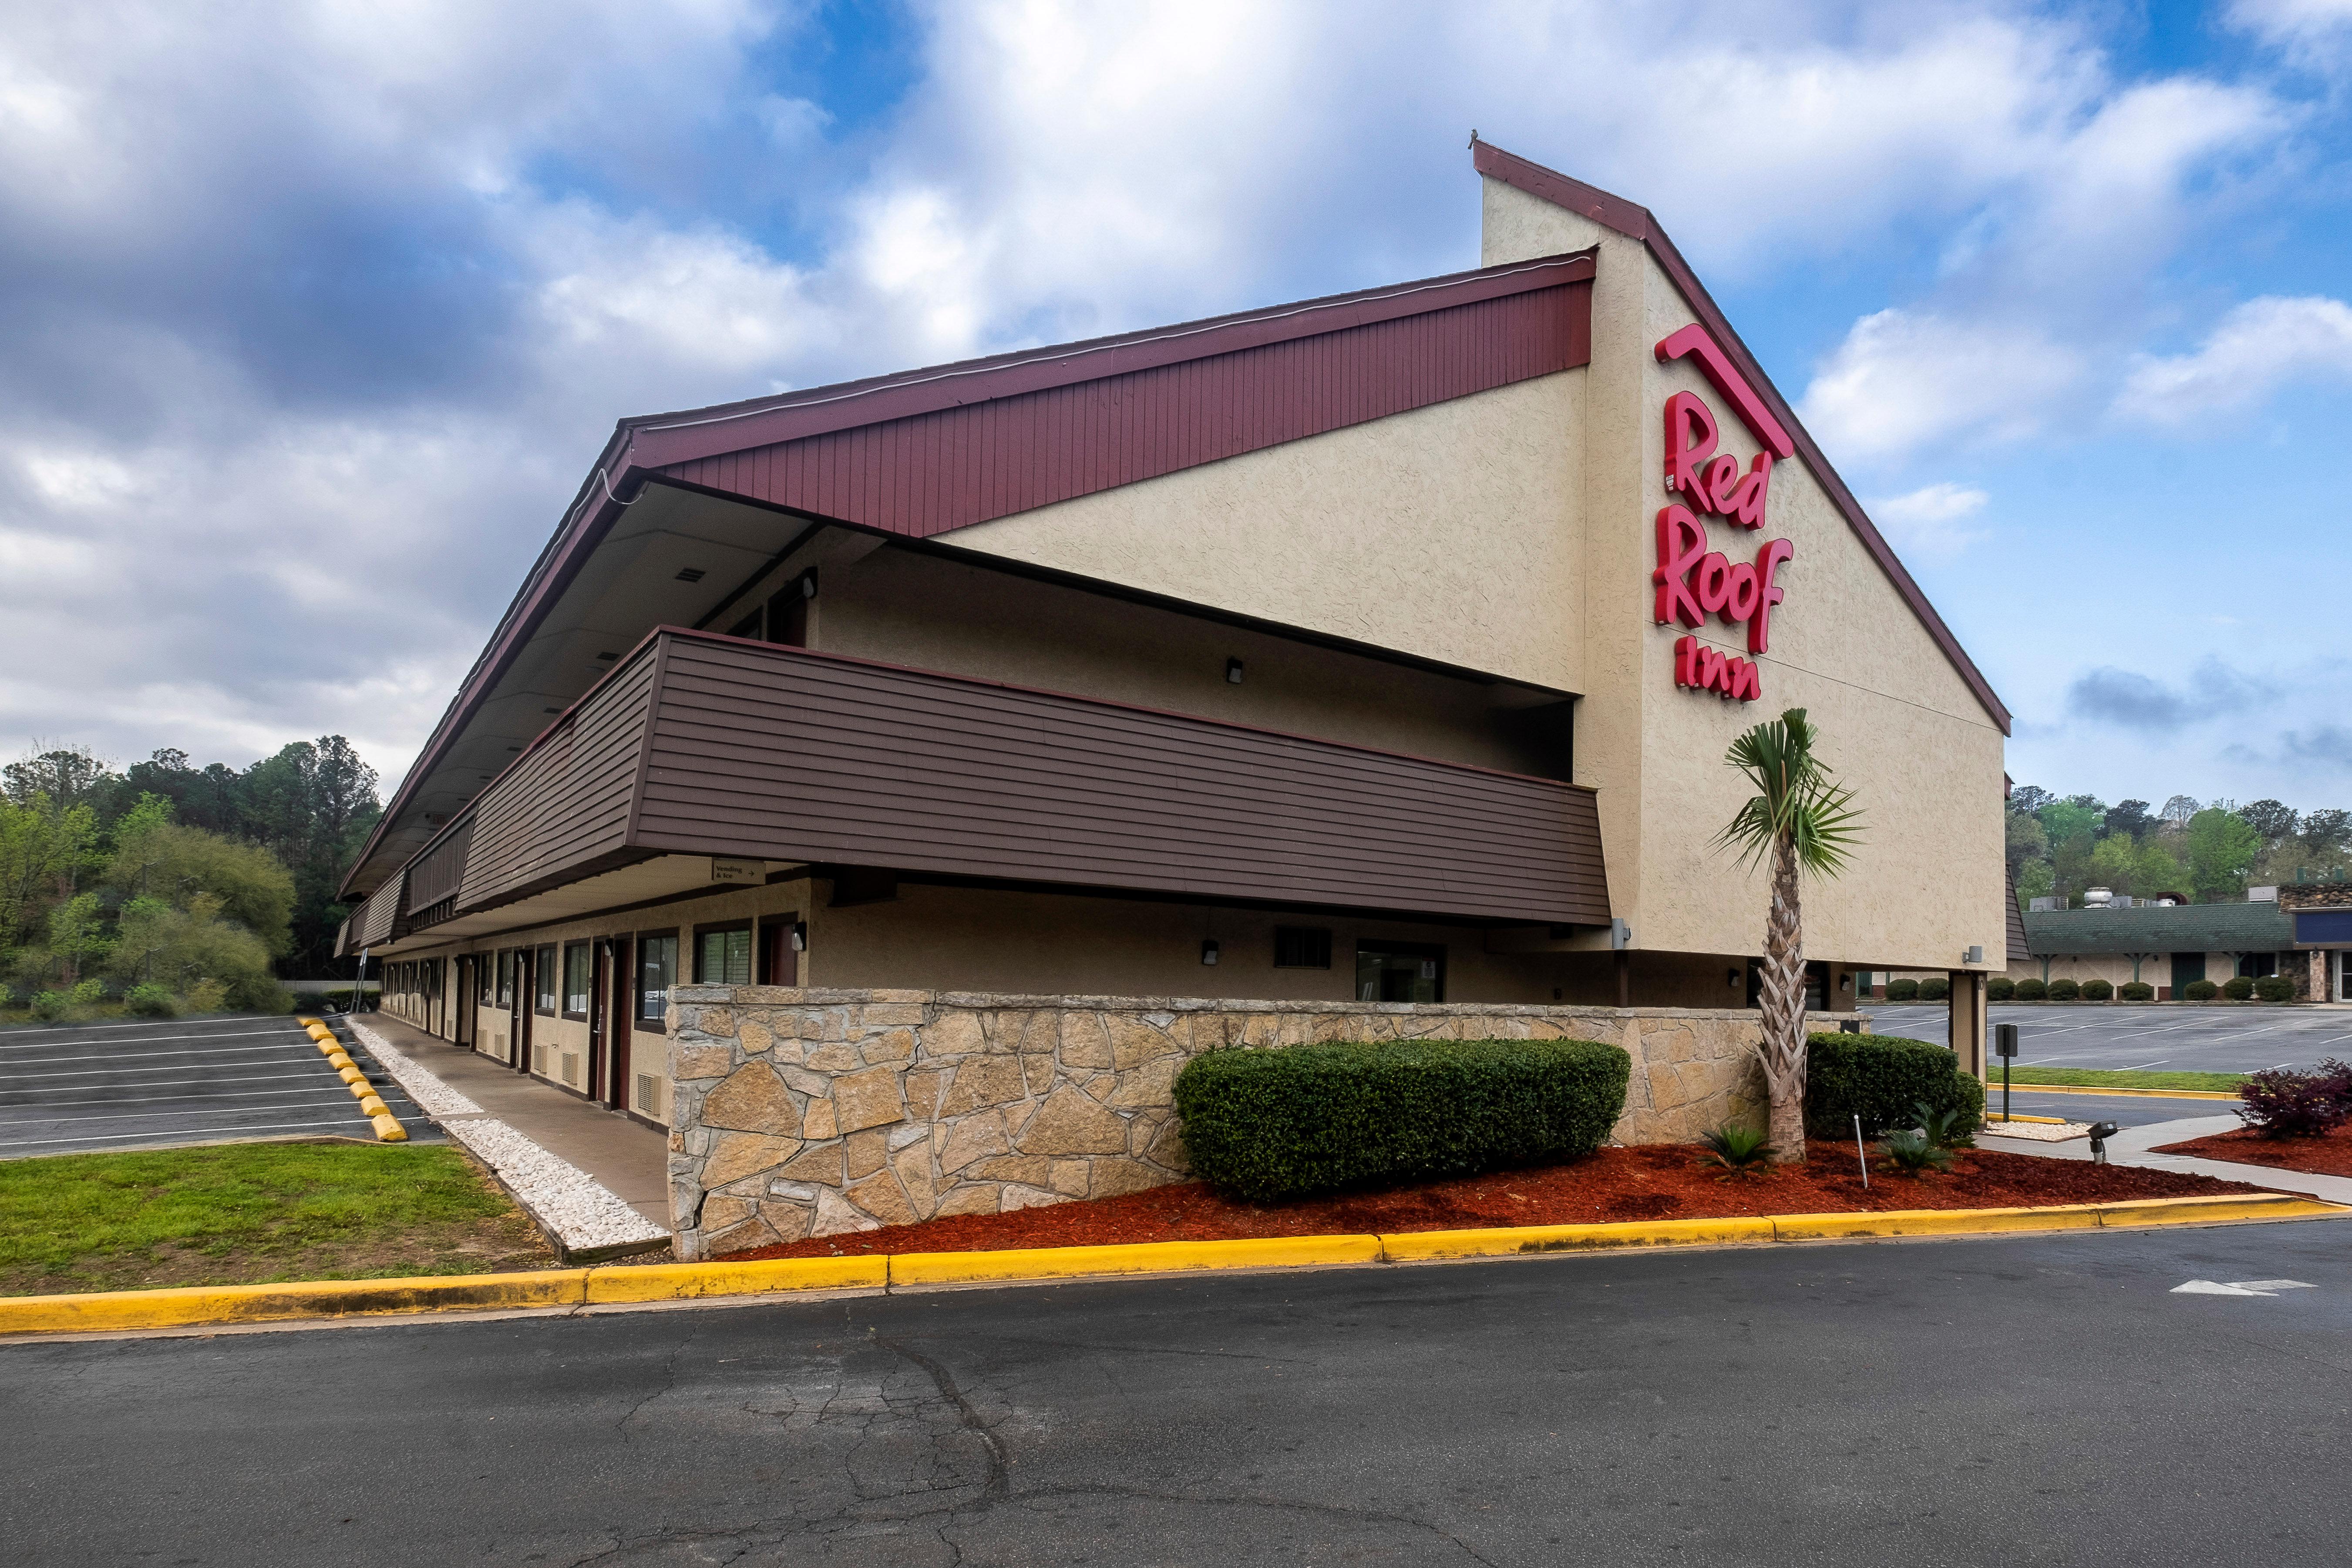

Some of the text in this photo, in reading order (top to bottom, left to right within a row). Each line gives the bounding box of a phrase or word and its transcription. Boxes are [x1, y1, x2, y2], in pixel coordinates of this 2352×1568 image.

[1666, 390, 1773, 530] Red
[1654, 503, 1793, 655] Roof
[716, 865, 742, 874] Vending
